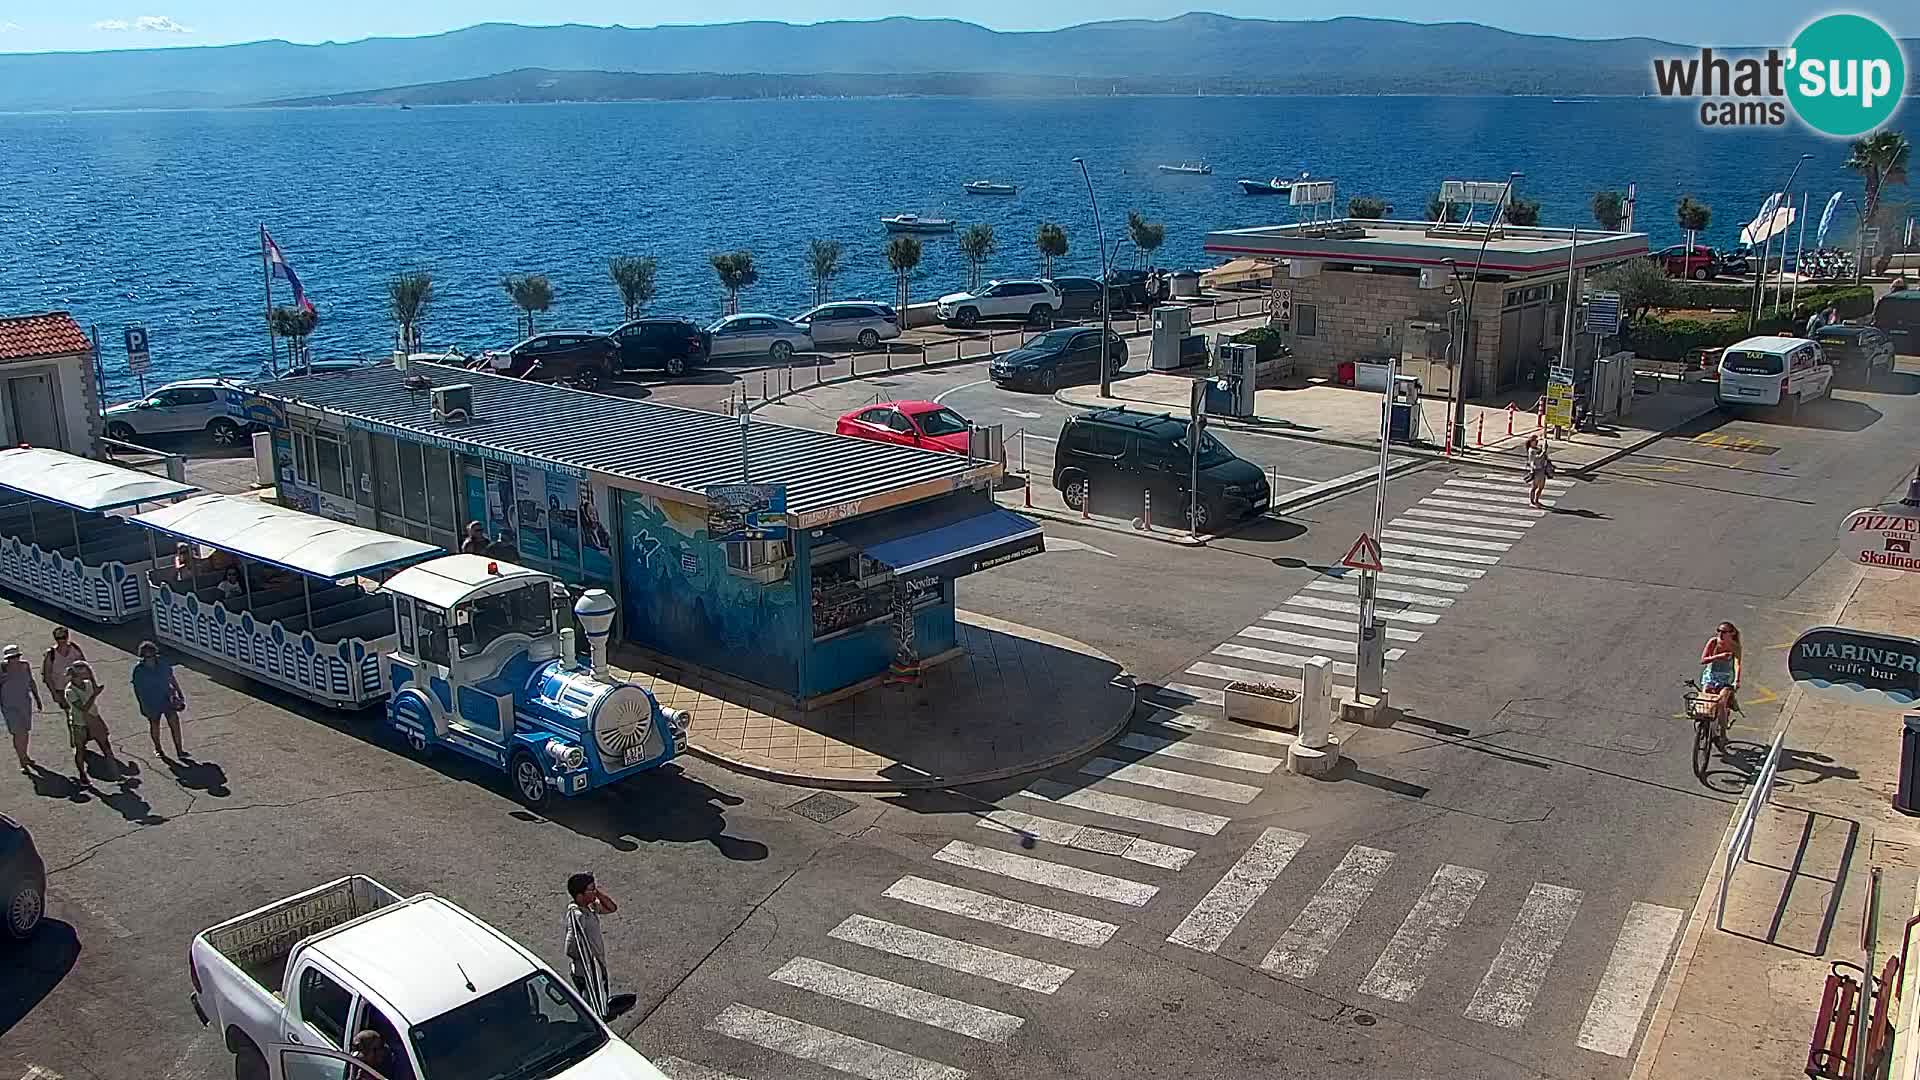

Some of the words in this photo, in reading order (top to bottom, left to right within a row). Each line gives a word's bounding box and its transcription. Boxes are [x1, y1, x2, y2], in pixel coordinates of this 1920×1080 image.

[130, 332, 142, 350] P
[437, 438, 468, 453] POSTAJA
[478, 446, 493, 458] BUS
[494, 449, 526, 465] STATION
[527, 458, 554, 473] TICKET
[556, 462, 582, 477] OFFICE
[1849, 515, 1920, 533] PIZZE
[1882, 530, 1918, 541] GRILL
[1829, 662, 1865, 676] caffe
[1871, 666, 1897, 681] bar
